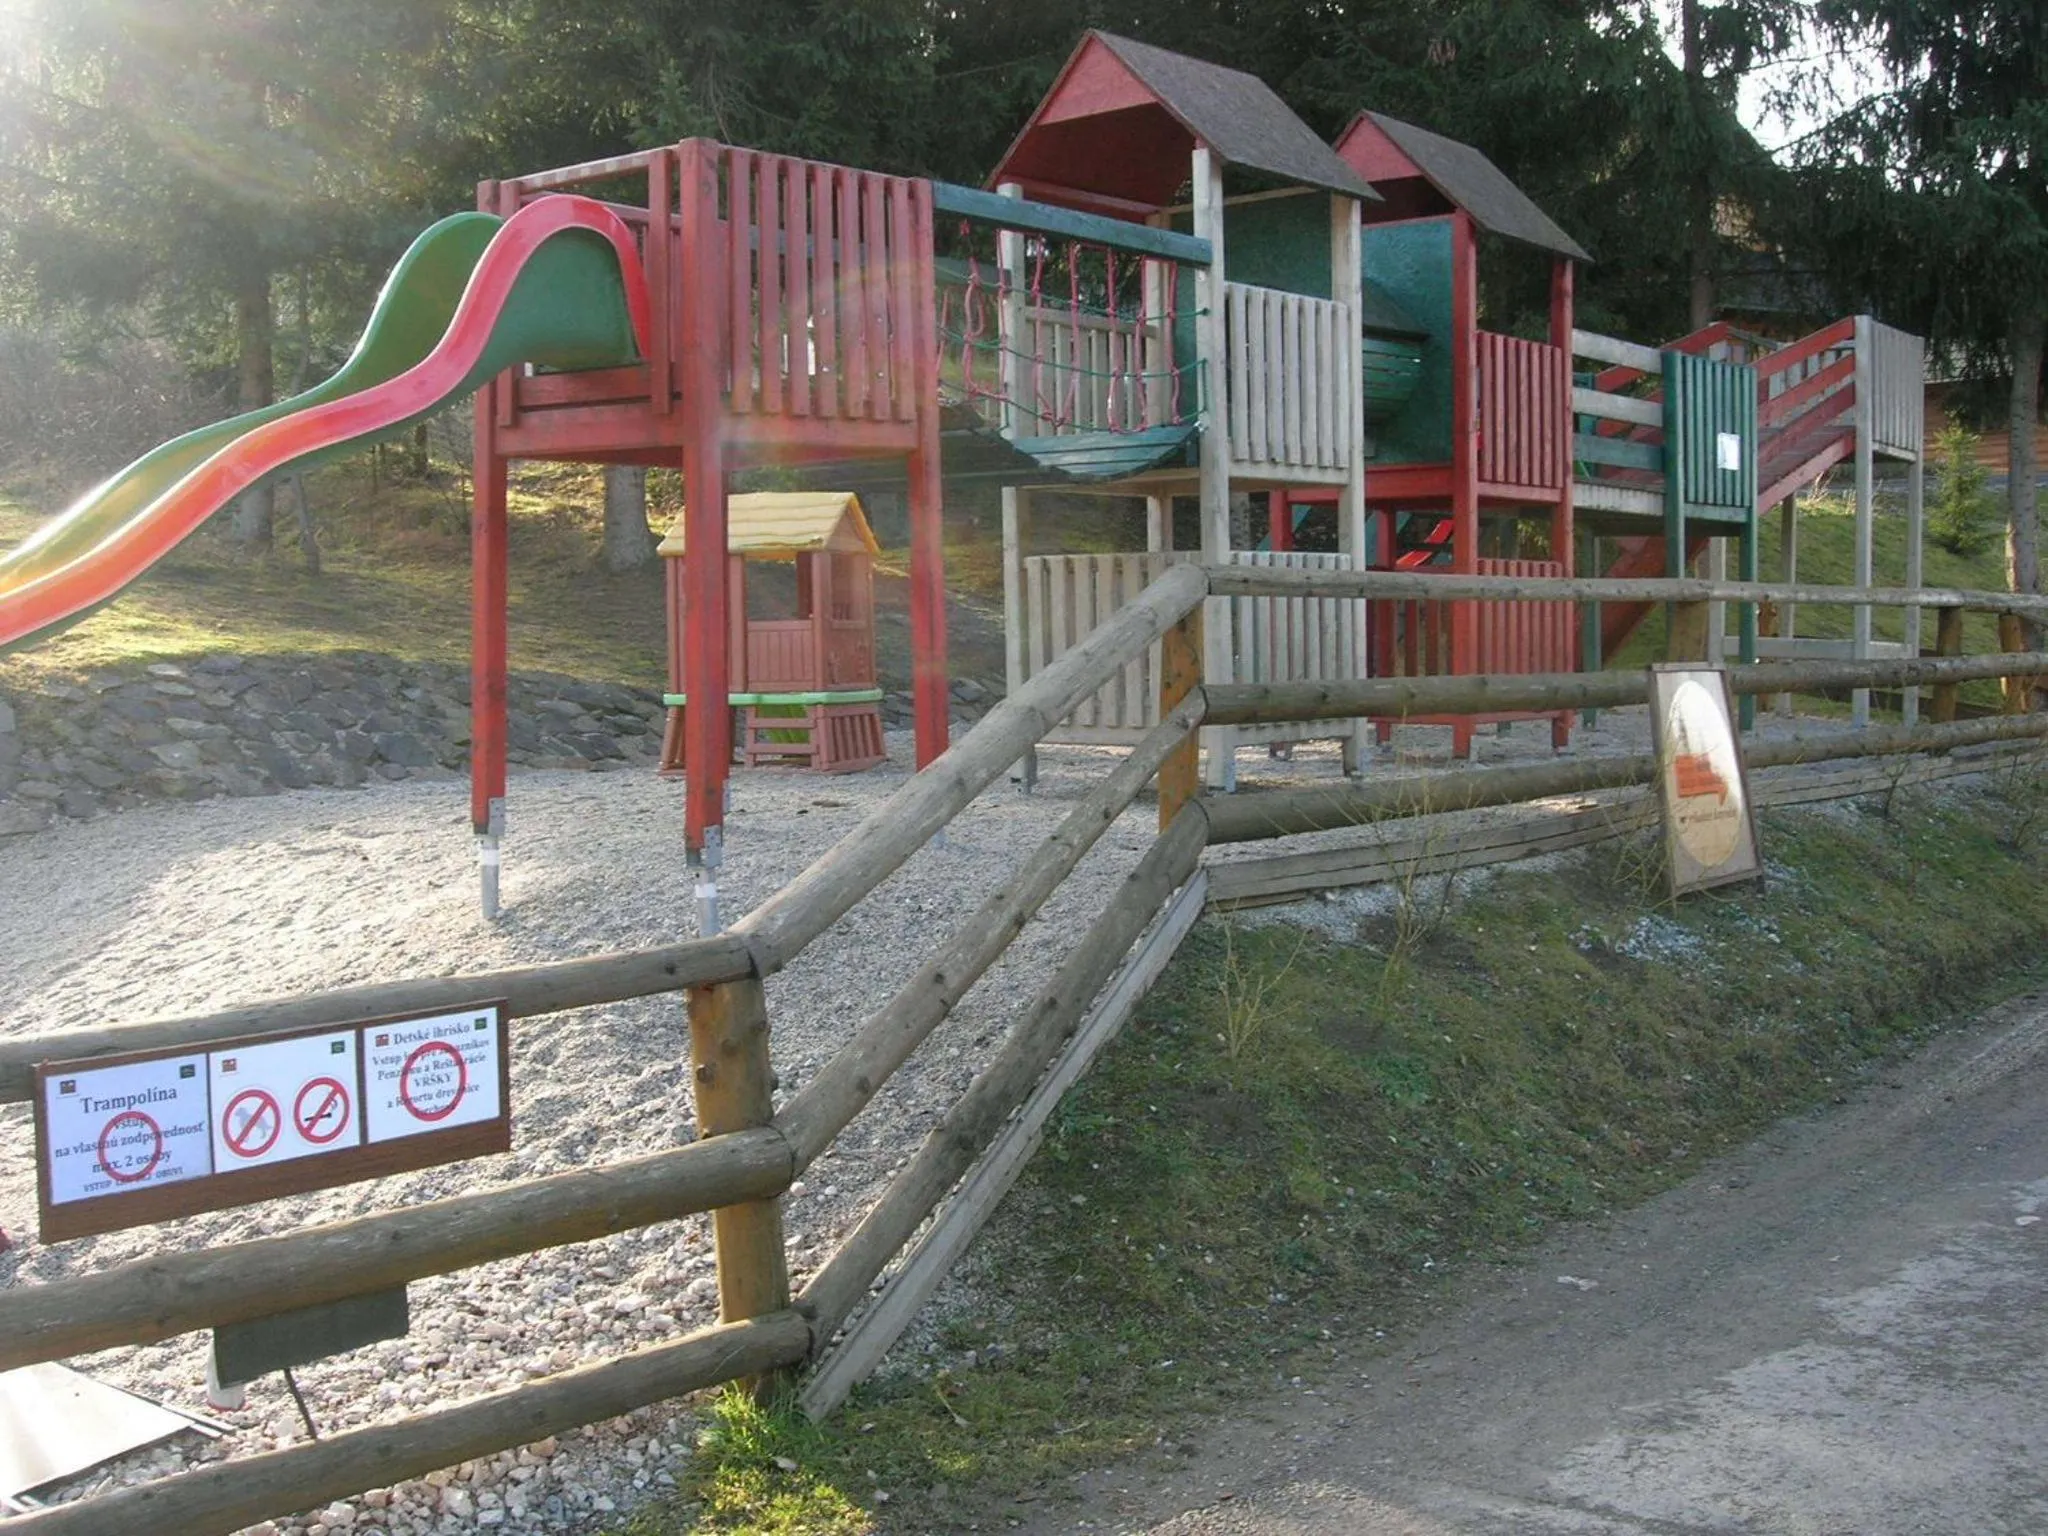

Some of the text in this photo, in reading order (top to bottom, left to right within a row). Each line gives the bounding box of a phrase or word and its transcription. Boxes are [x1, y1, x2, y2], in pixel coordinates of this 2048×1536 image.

[80, 1087, 178, 1114] Trampolína
[55, 1146, 70, 1158] na
[124, 1155, 133, 1167] 2
